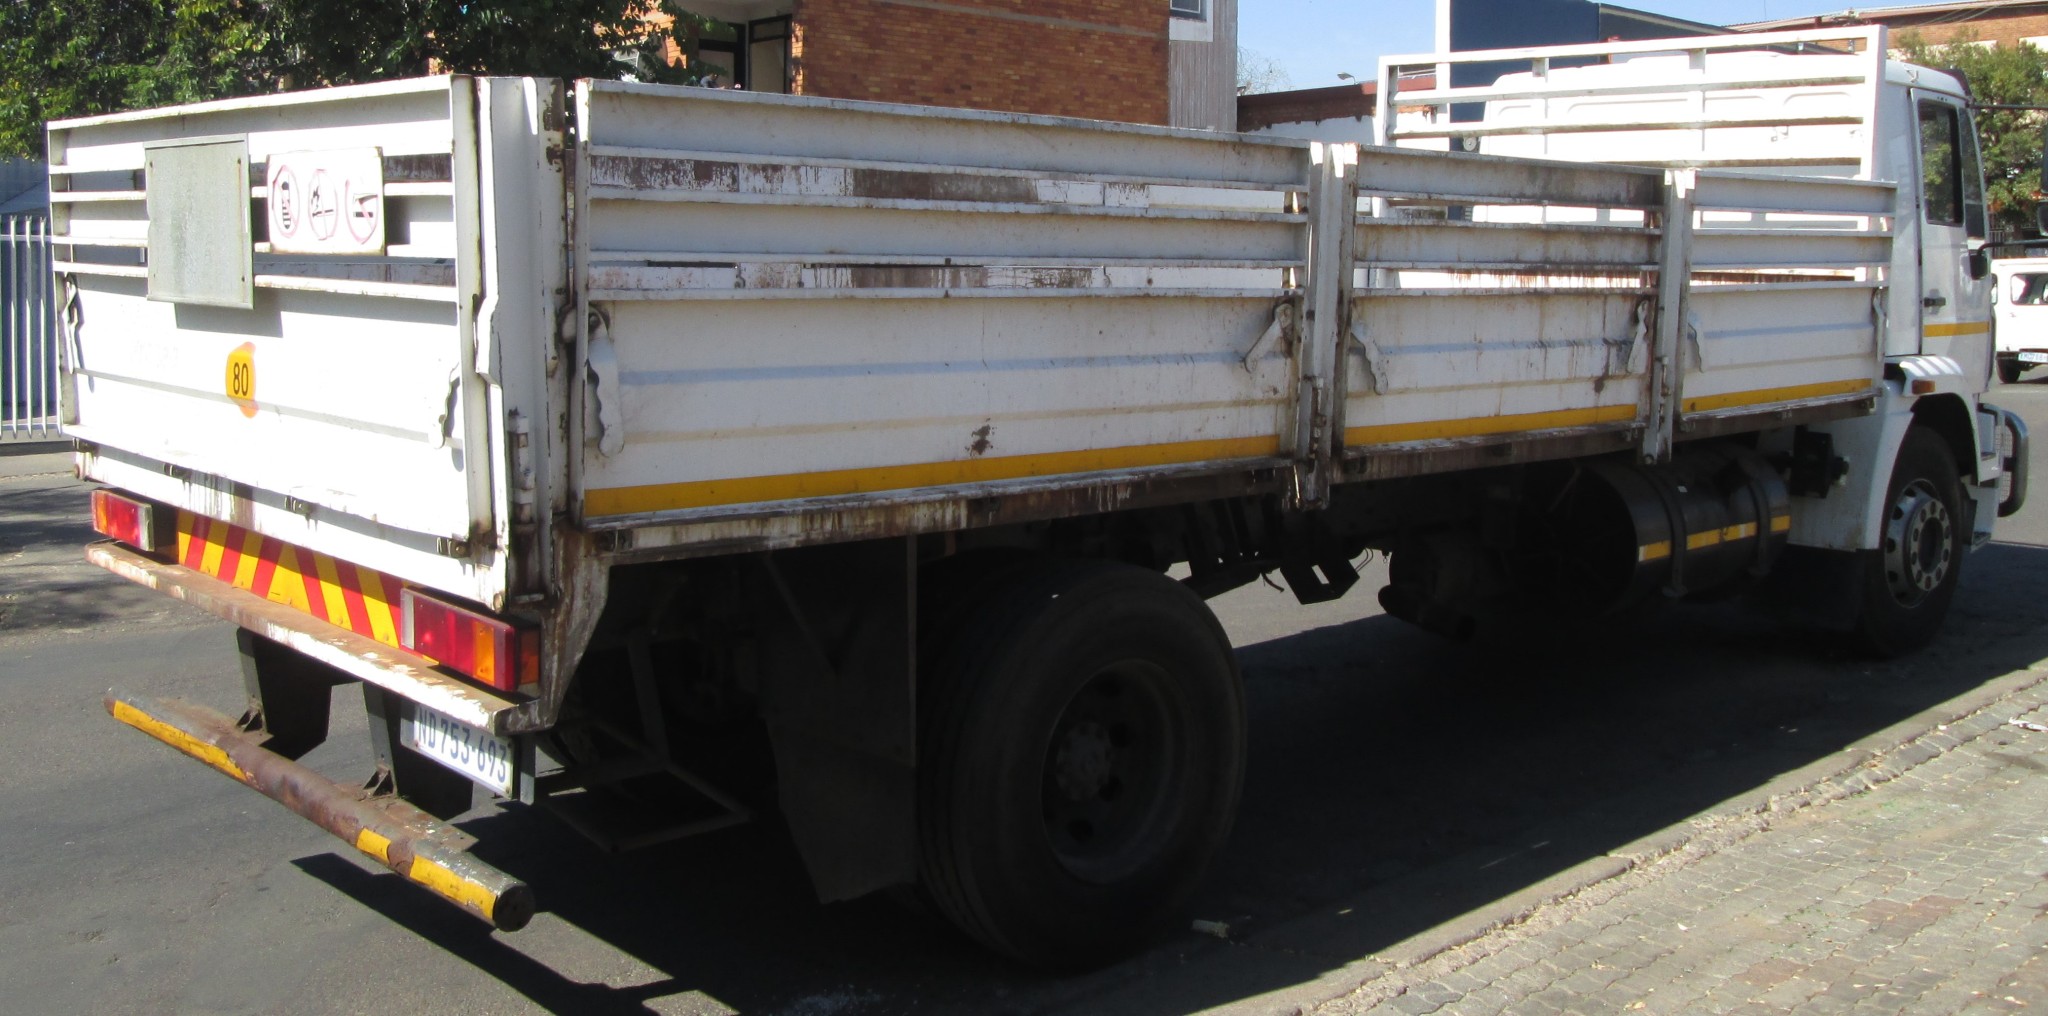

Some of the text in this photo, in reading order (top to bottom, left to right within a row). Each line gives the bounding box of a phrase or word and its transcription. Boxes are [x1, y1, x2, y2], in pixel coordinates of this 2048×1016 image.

[233, 362, 249, 396] 80
[419, 708, 507, 783] ND 753-693
